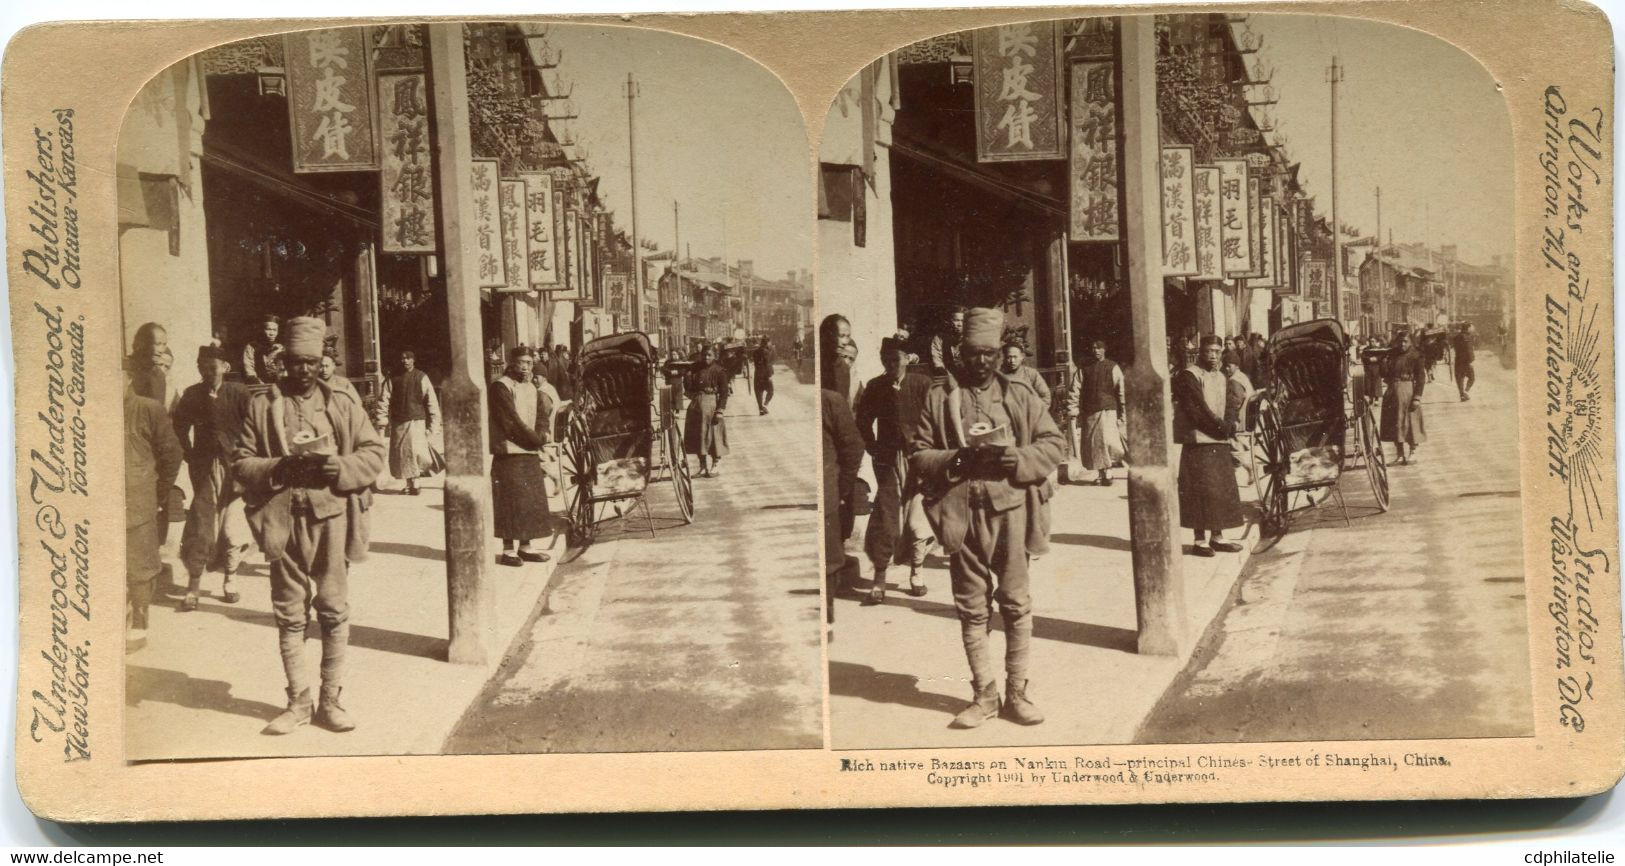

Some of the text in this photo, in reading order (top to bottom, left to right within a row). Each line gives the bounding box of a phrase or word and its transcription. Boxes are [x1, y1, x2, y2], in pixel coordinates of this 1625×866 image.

[22, 126, 60, 290] Publishers.
[1567, 107, 1611, 665] Works and Studios
[1572, 391, 1597, 449] SCULPTURE
[36, 505, 66, 540] &
[30, 540, 67, 743] Underwood
[839, 757, 875, 772] Rich
[879, 759, 925, 771] native
[930, 757, 985, 771] Bazaars
[989, 760, 1008, 770] on
[1257, 754, 1302, 768] Street
[1305, 753, 1321, 767] of
[1325, 753, 1398, 771] Shanghai,
[927, 772, 992, 787] Copyright
[996, 772, 1025, 783] 1901
[1031, 771, 1047, 786] by
[1052, 771, 1124, 784] Underwood
[1128, 770, 1139, 784] &
